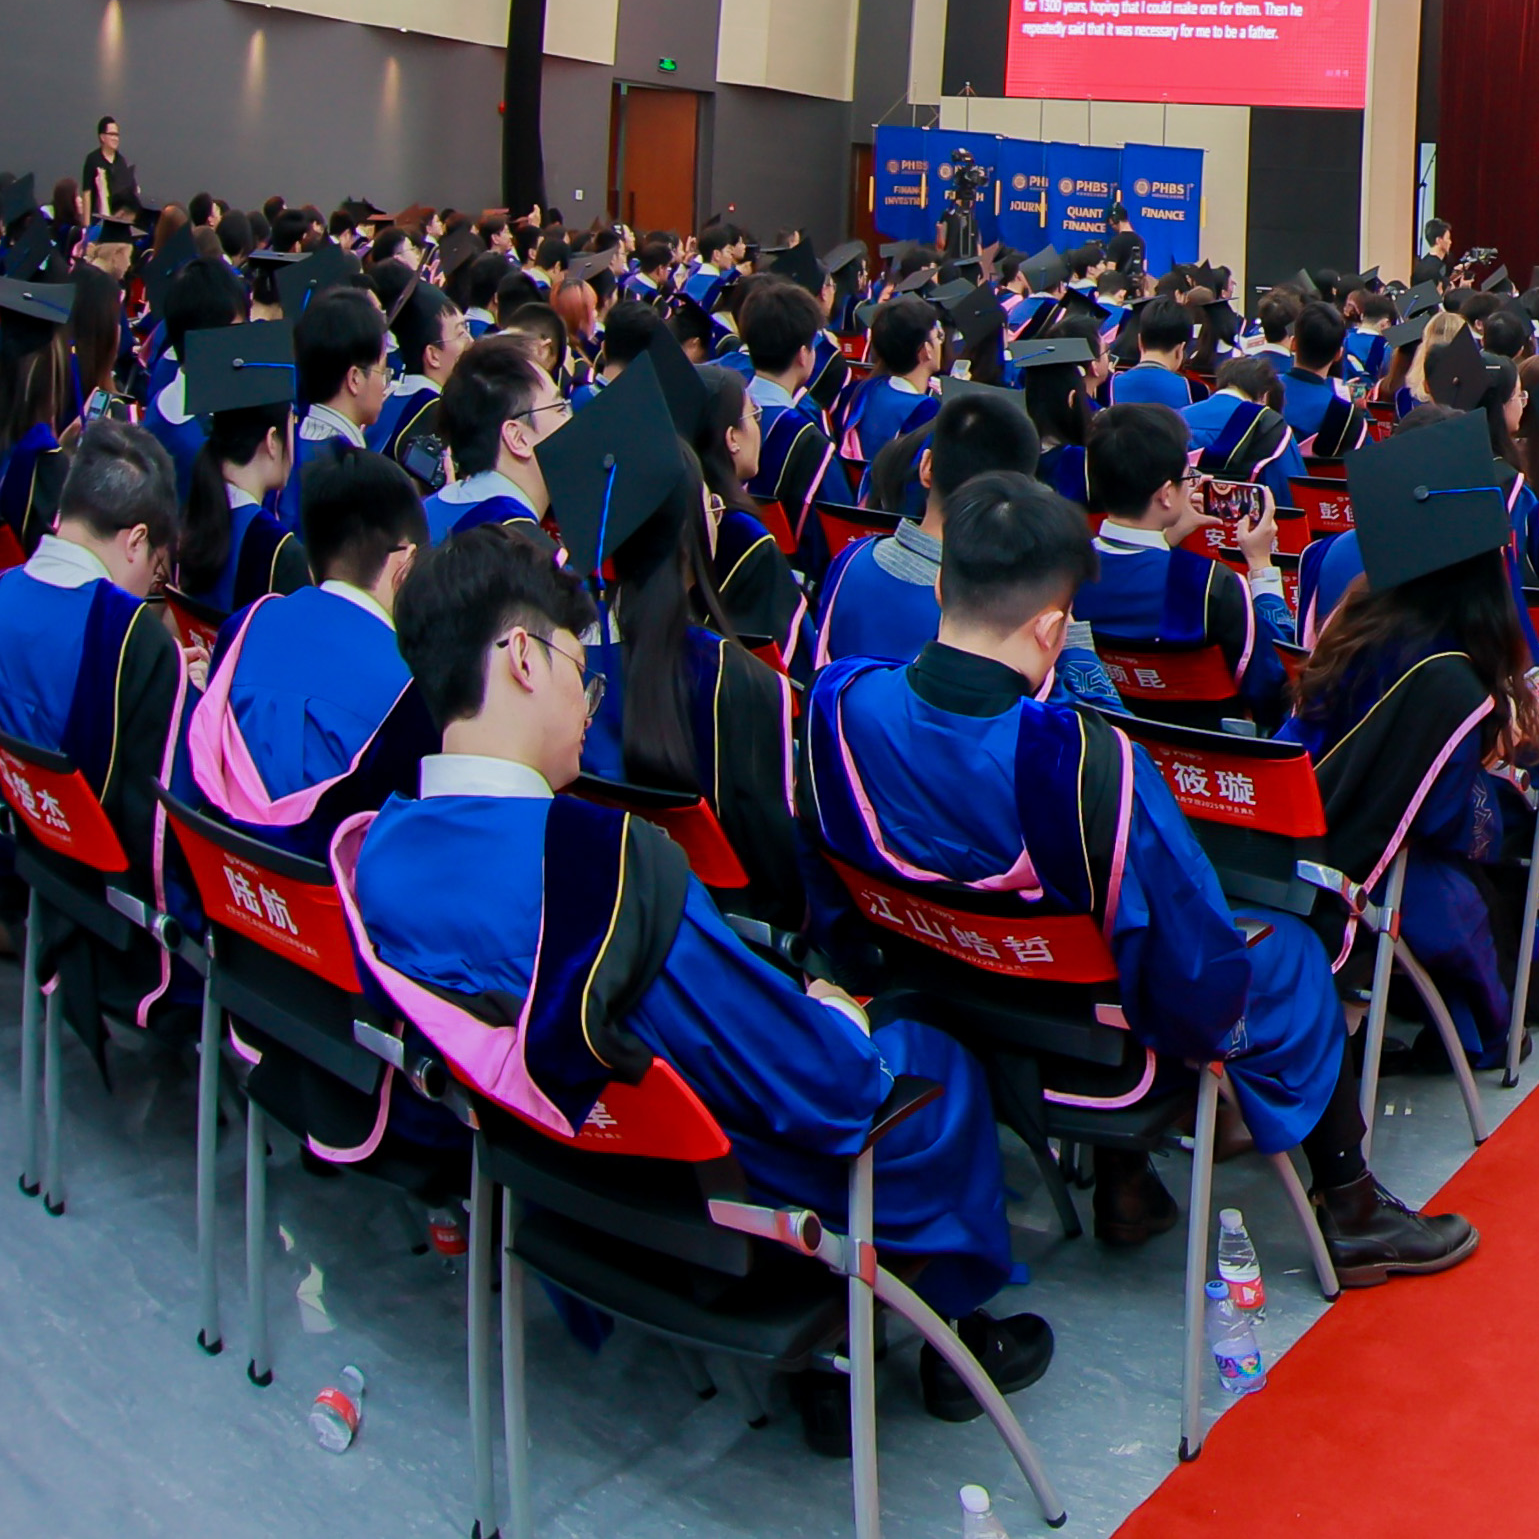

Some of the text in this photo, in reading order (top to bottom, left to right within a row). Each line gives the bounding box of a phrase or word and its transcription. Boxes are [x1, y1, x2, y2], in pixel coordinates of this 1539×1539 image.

[1089, 0, 1120, 17] hoping
[1122, 0, 1140, 14] that
[1146, 0, 1172, 14] could
[1173, 2, 1198, 14] make
[1200, 4, 1218, 15] one
[1219, 1, 1234, 16] for
[1264, 1, 1288, 16] Then
[1290, 2, 1303, 17] he
[1022, 22, 1066, 38] repeatedly
[1068, 22, 1086, 35] said
[1087, 22, 1106, 36] that
[1115, 26, 1133, 36] was
[1134, 26, 1179, 40] necessary
[1180, 24, 1194, 38] for
[1195, 26, 1210, 38] me
[1212, 26, 1223, 38] to
[1224, 25, 1238, 38] be
[1075, 179, 1108, 193] PHBS
[1152, 181, 1185, 195] PHBS
[1066, 205, 1104, 219] QUANT
[1142, 207, 1185, 221] FINANCE
[1062, 219, 1107, 234] FINANCE
[1154, 760, 1258, 806] 筱璇
[222, 864, 299, 936] 陆航
